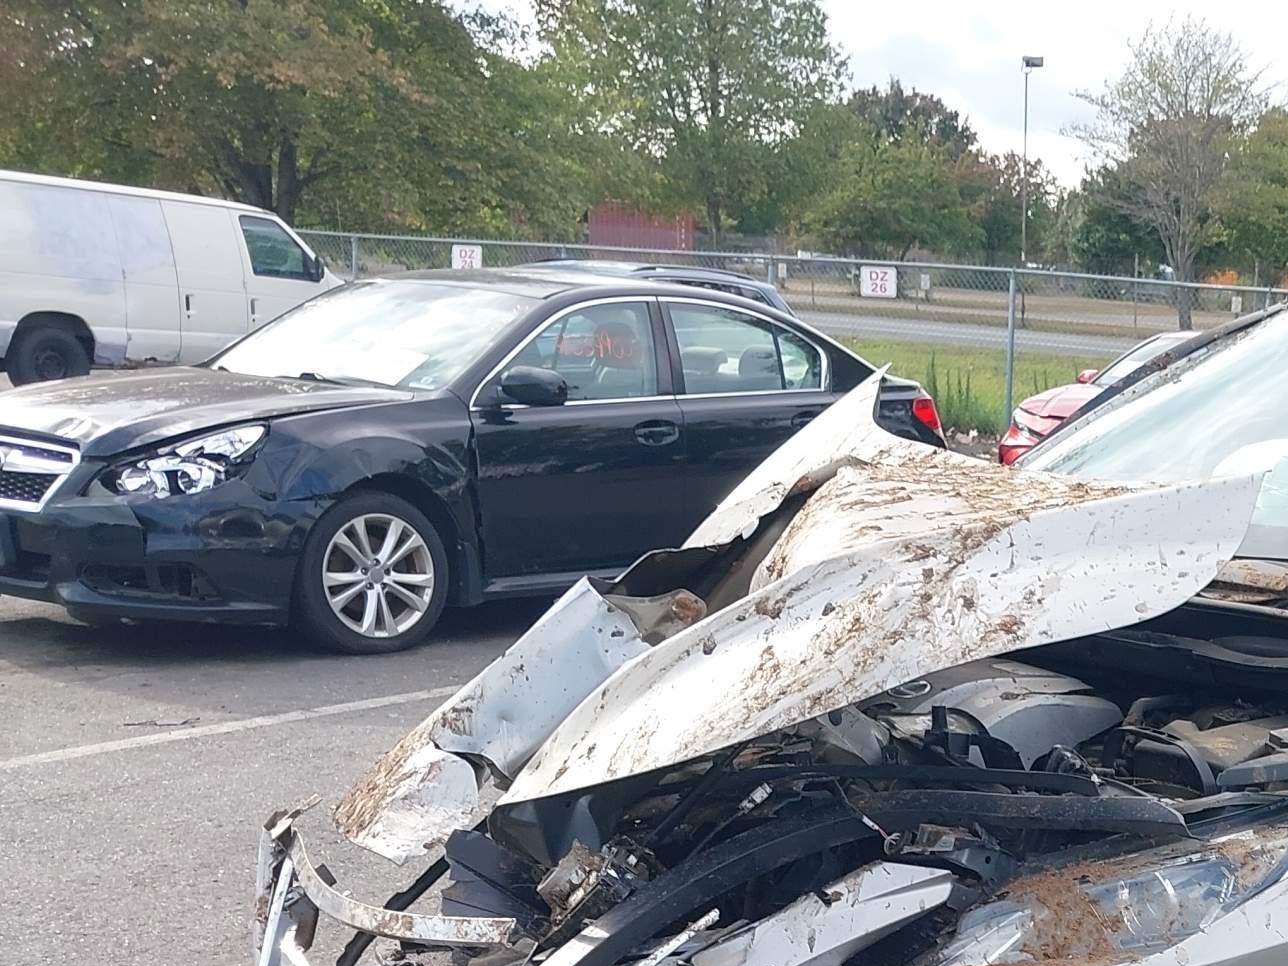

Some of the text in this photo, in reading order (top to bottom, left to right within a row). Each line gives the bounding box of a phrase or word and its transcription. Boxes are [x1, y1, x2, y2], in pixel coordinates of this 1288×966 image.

[459, 249, 475, 259] DZ
[869, 271, 888, 281] DZ
[871, 282, 887, 293] 26
